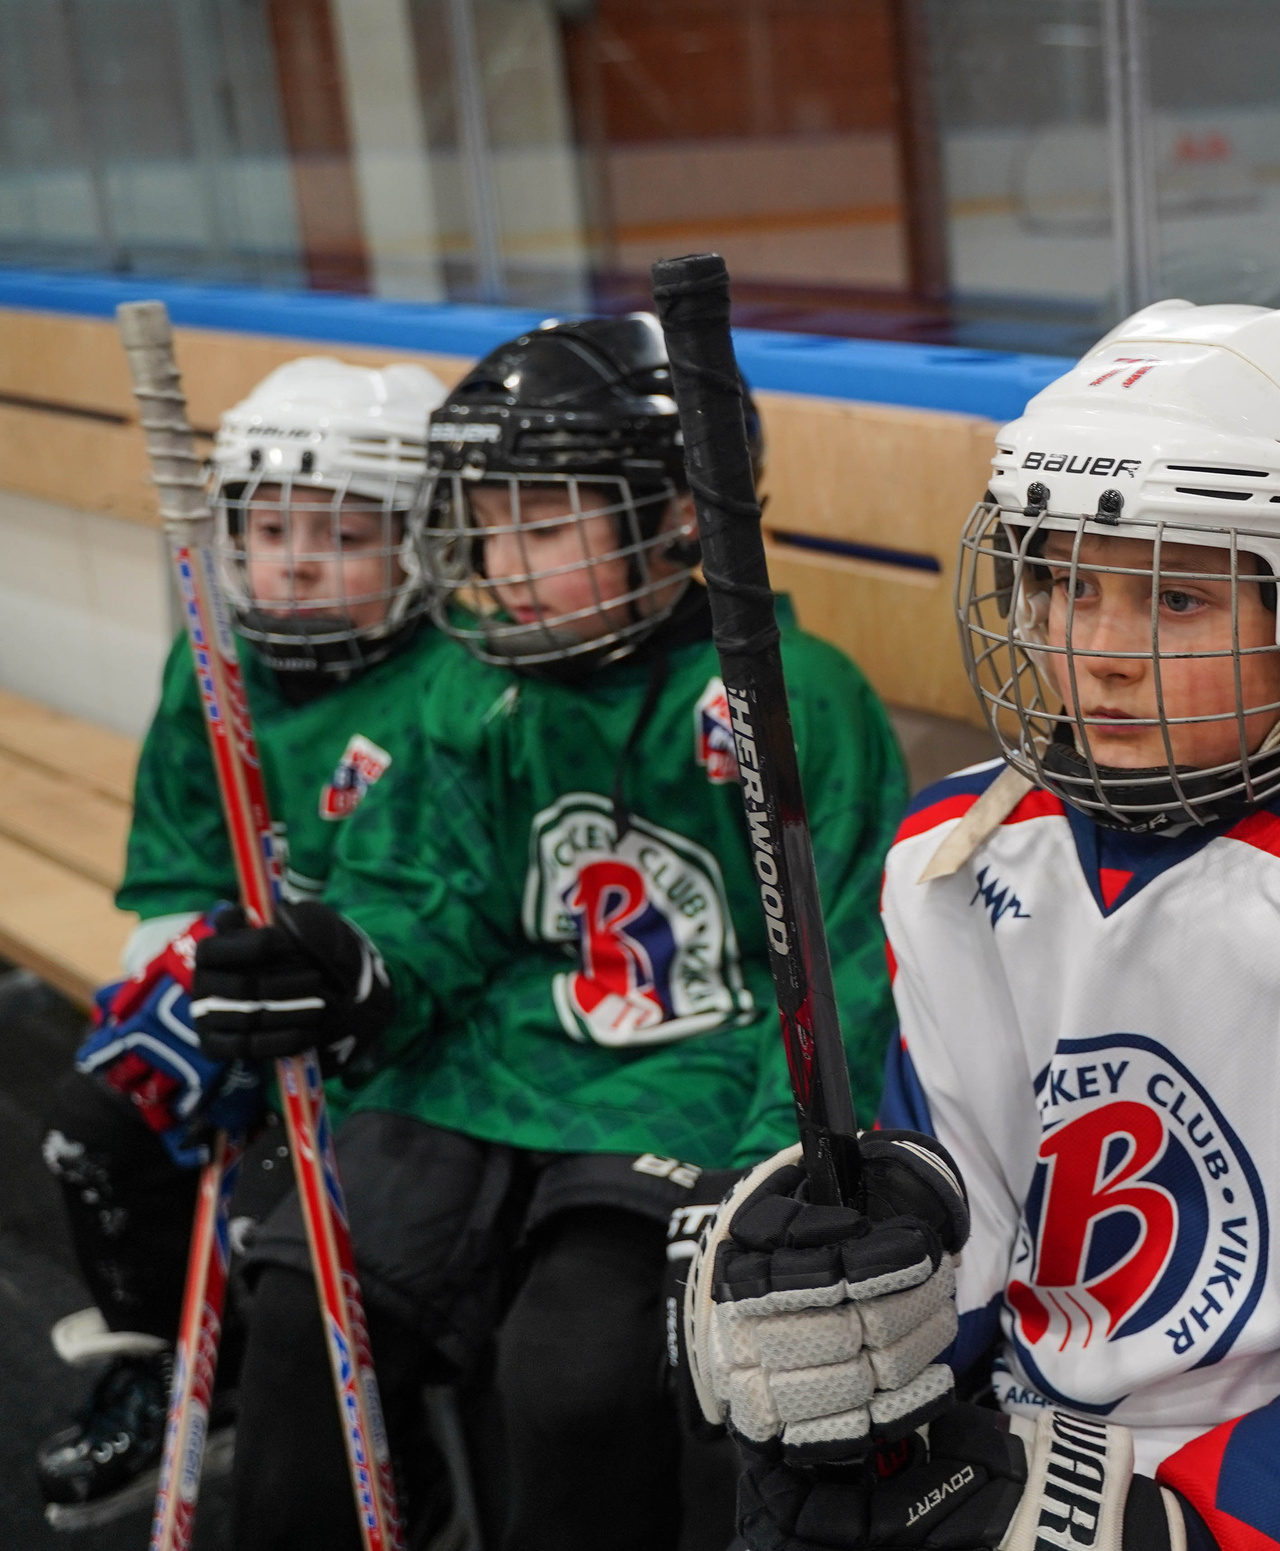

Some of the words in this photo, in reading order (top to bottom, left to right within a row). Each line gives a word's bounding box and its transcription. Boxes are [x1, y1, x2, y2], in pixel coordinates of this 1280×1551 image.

[1021, 451, 1142, 478] BAUER
[1146, 1073, 1230, 1181] CLUB
[1164, 1216, 1248, 1357] VIKHR
[905, 1464, 975, 1528] COVERT
[1034, 1410, 1106, 1551] WAR
